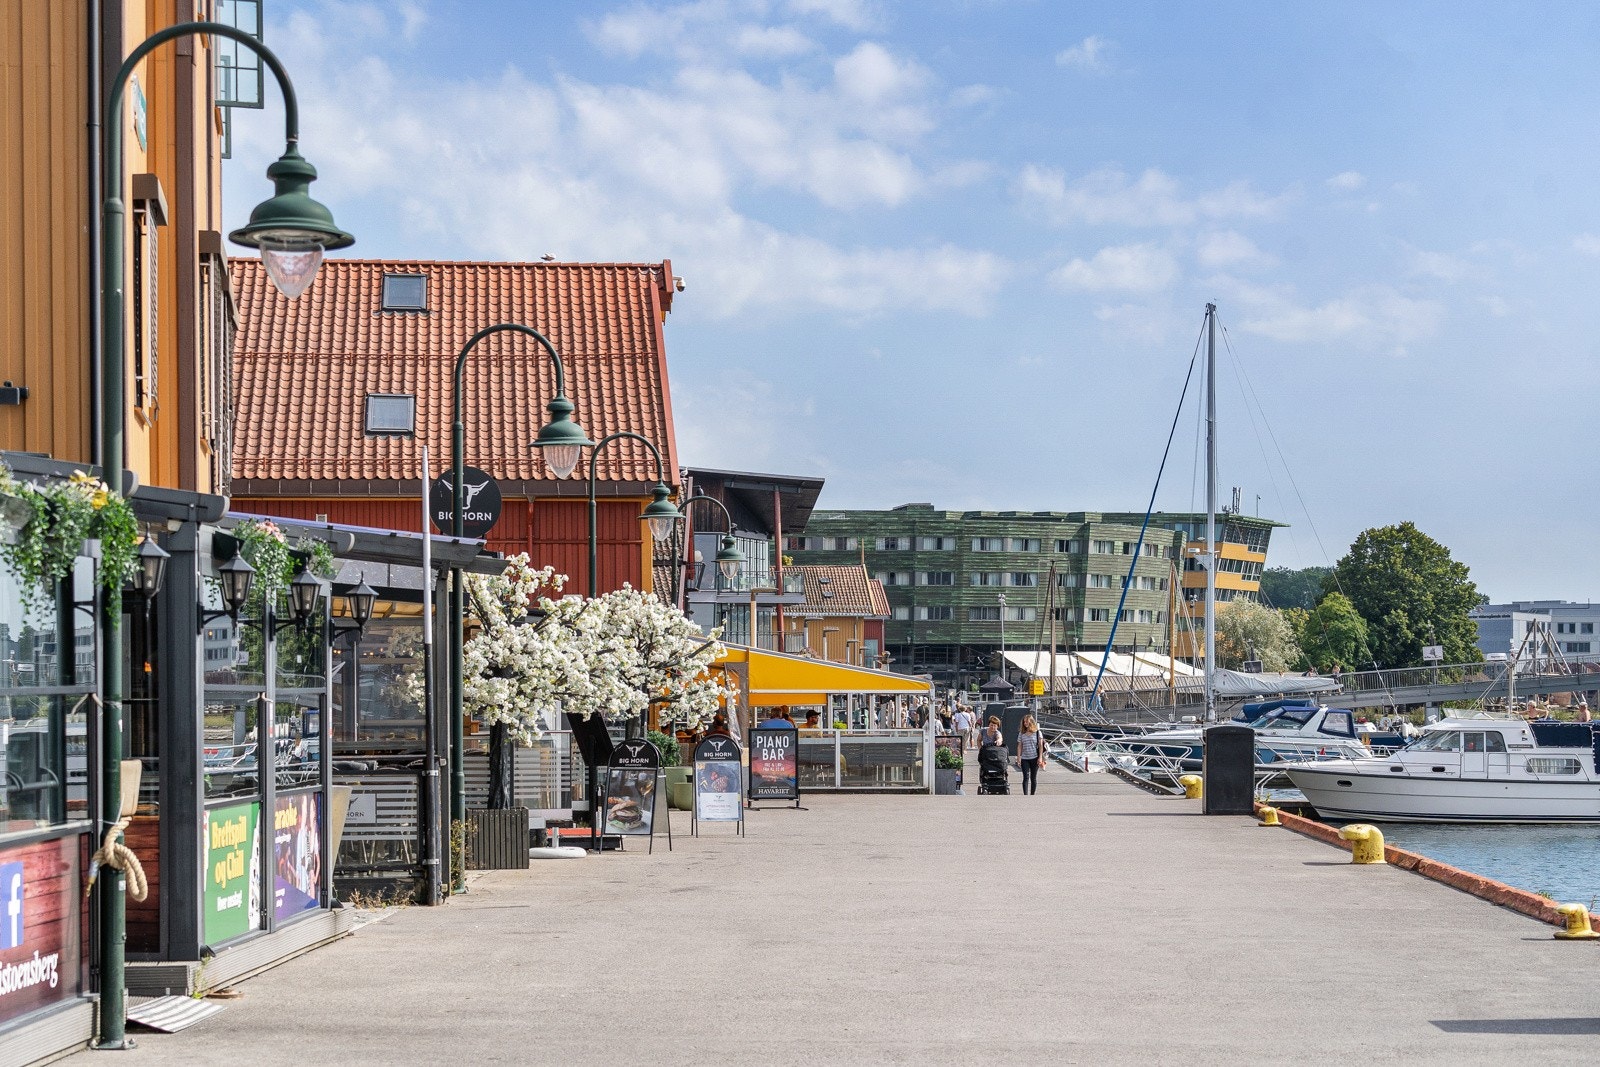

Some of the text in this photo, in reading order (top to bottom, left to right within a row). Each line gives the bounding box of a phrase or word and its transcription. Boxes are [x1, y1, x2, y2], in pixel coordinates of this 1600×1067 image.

[462, 512, 492, 521] HORN
[756, 735, 790, 748] PIANO
[762, 748, 785, 761] BAR
[274, 802, 298, 830] araoke
[211, 815, 247, 850] Brettspill
[214, 849, 244, 890] og Chill
